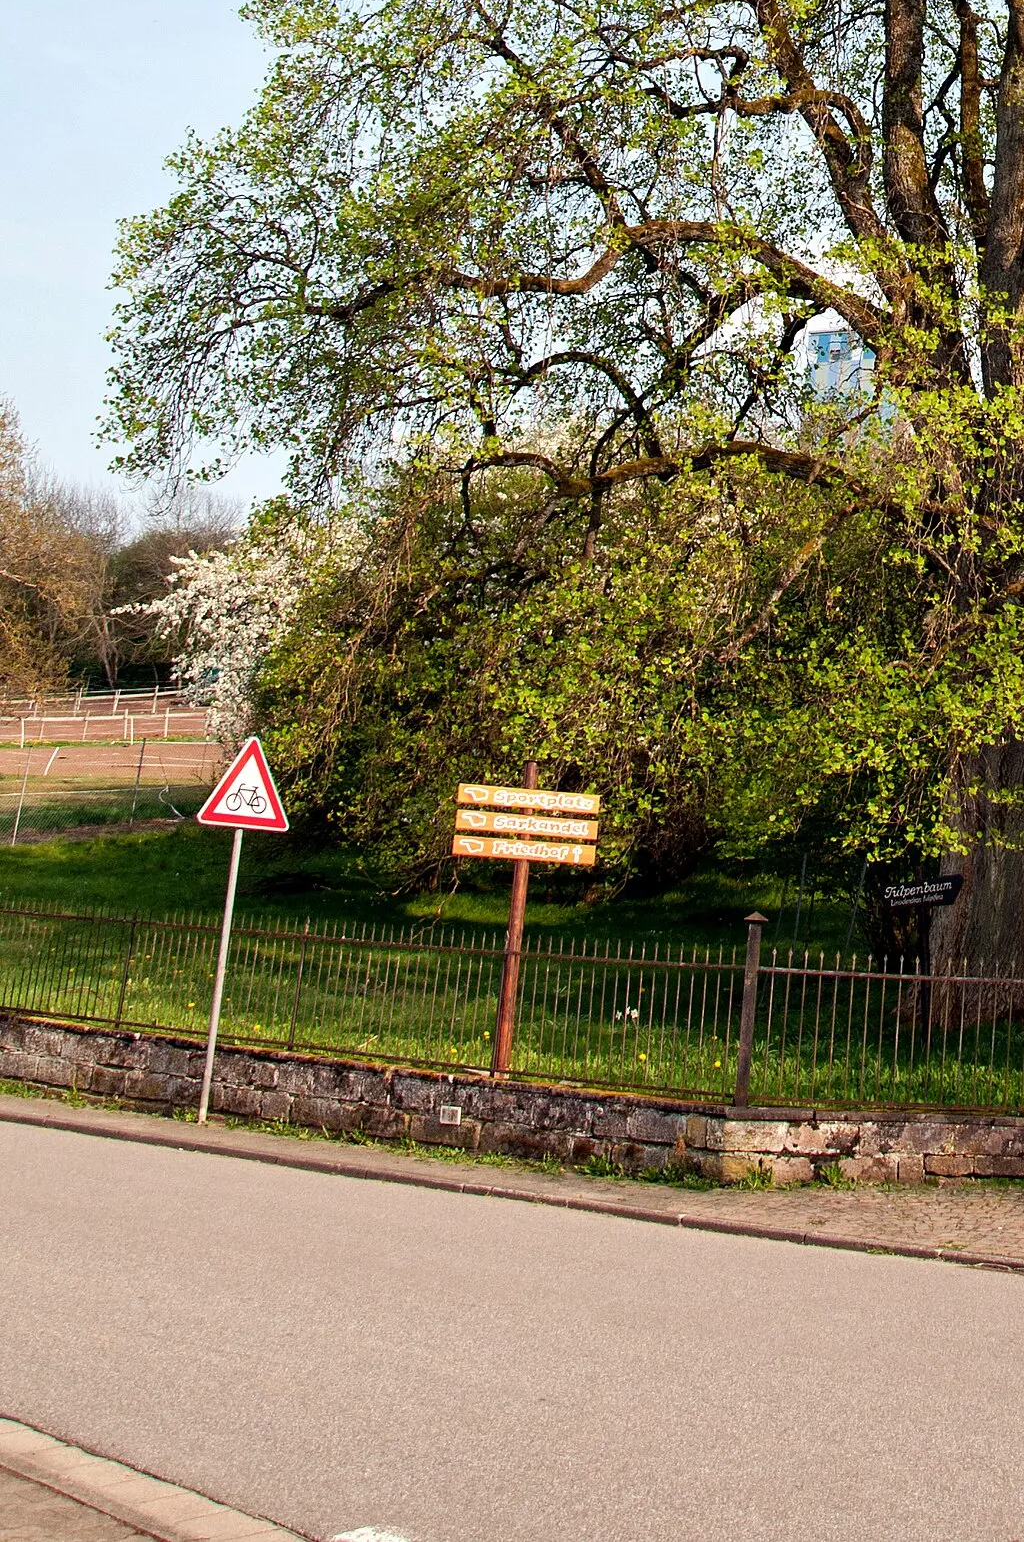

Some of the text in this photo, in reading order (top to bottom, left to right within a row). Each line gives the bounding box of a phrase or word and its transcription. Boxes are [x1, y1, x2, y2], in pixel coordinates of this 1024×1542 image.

[493, 789, 594, 810] Sportplatz
[493, 815, 589, 835] Sarkandel
[492, 841, 569, 860] Friedhof
[884, 881, 952, 899] Tulpenbaum
